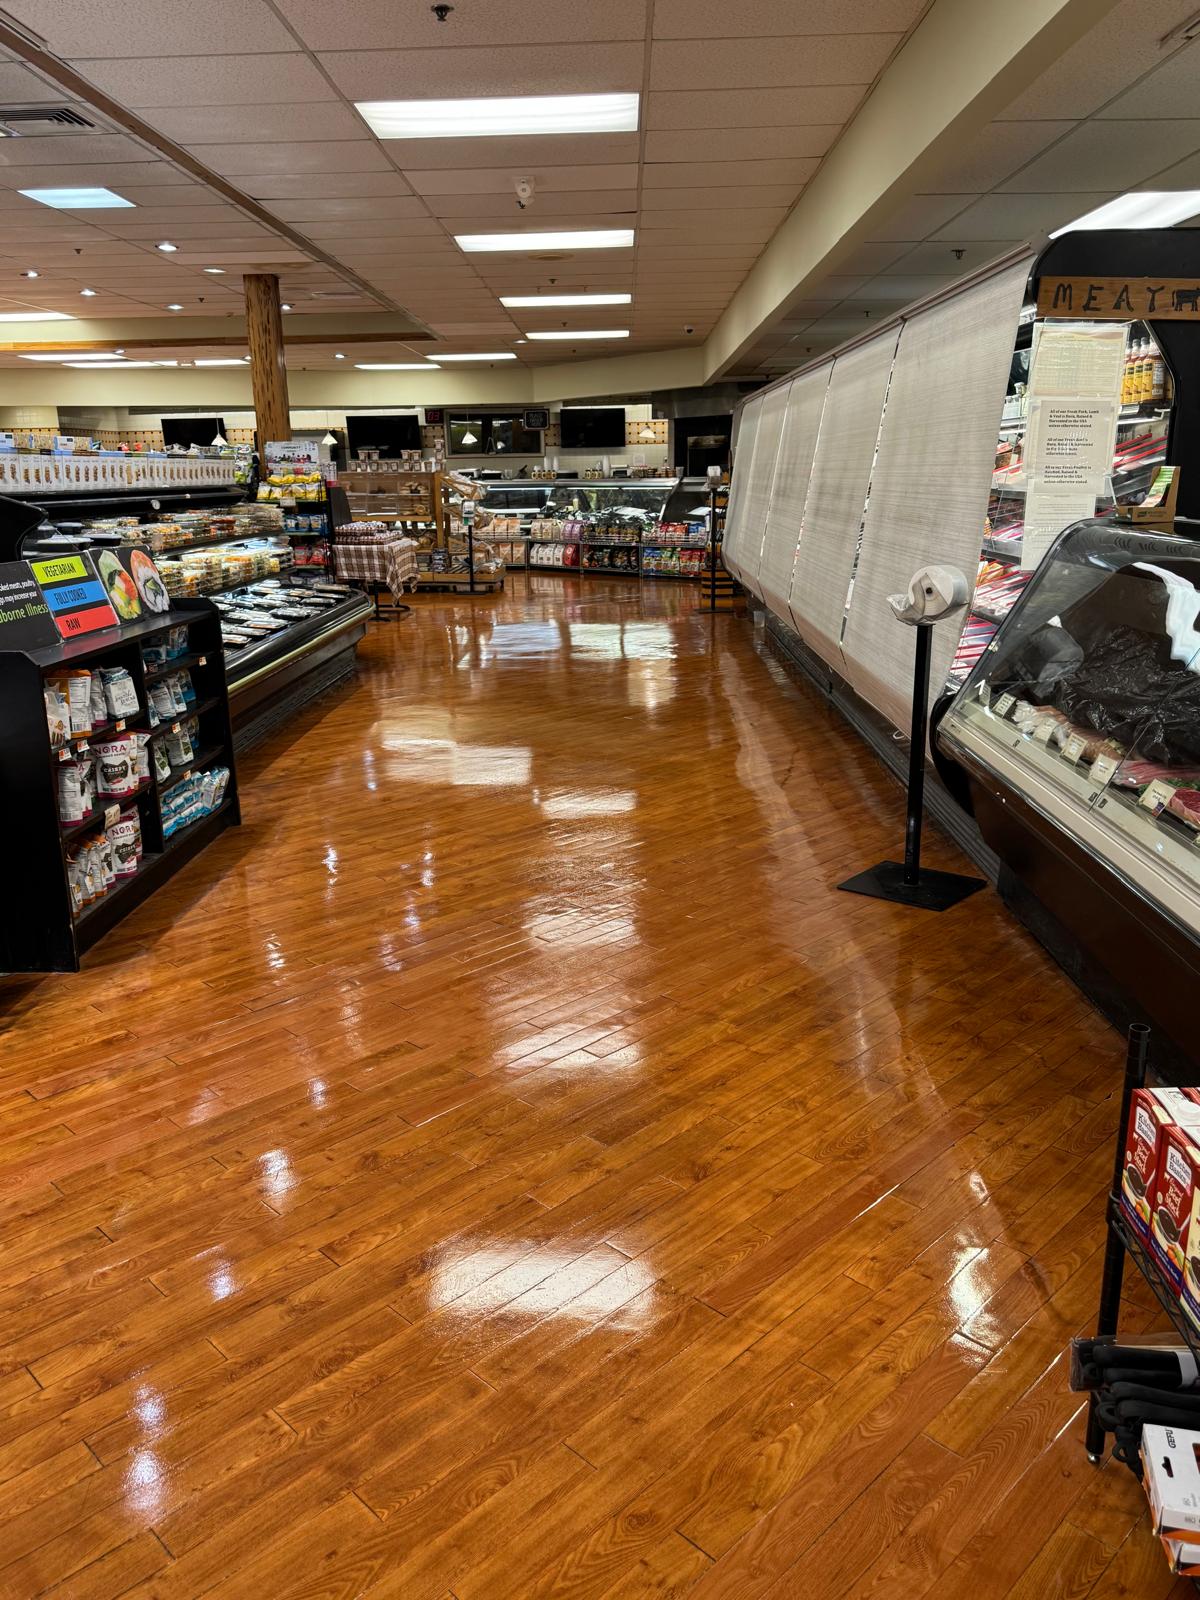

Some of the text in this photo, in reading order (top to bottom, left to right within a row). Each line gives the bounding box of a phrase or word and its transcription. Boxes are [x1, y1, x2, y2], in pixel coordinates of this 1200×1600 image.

[42, 562, 76, 578] VEGETARIAN
[54, 588, 88, 606] FULLY COOKED
[25, 602, 49, 616] Illness
[66, 618, 81, 631] RAW
[96, 745, 127, 756] NORA
[1137, 1121, 1154, 1144] Basics
[1138, 1112, 1155, 1137] Kitchen
[1169, 1162, 1189, 1185] Basics
[1170, 1152, 1191, 1178] Kitchen
